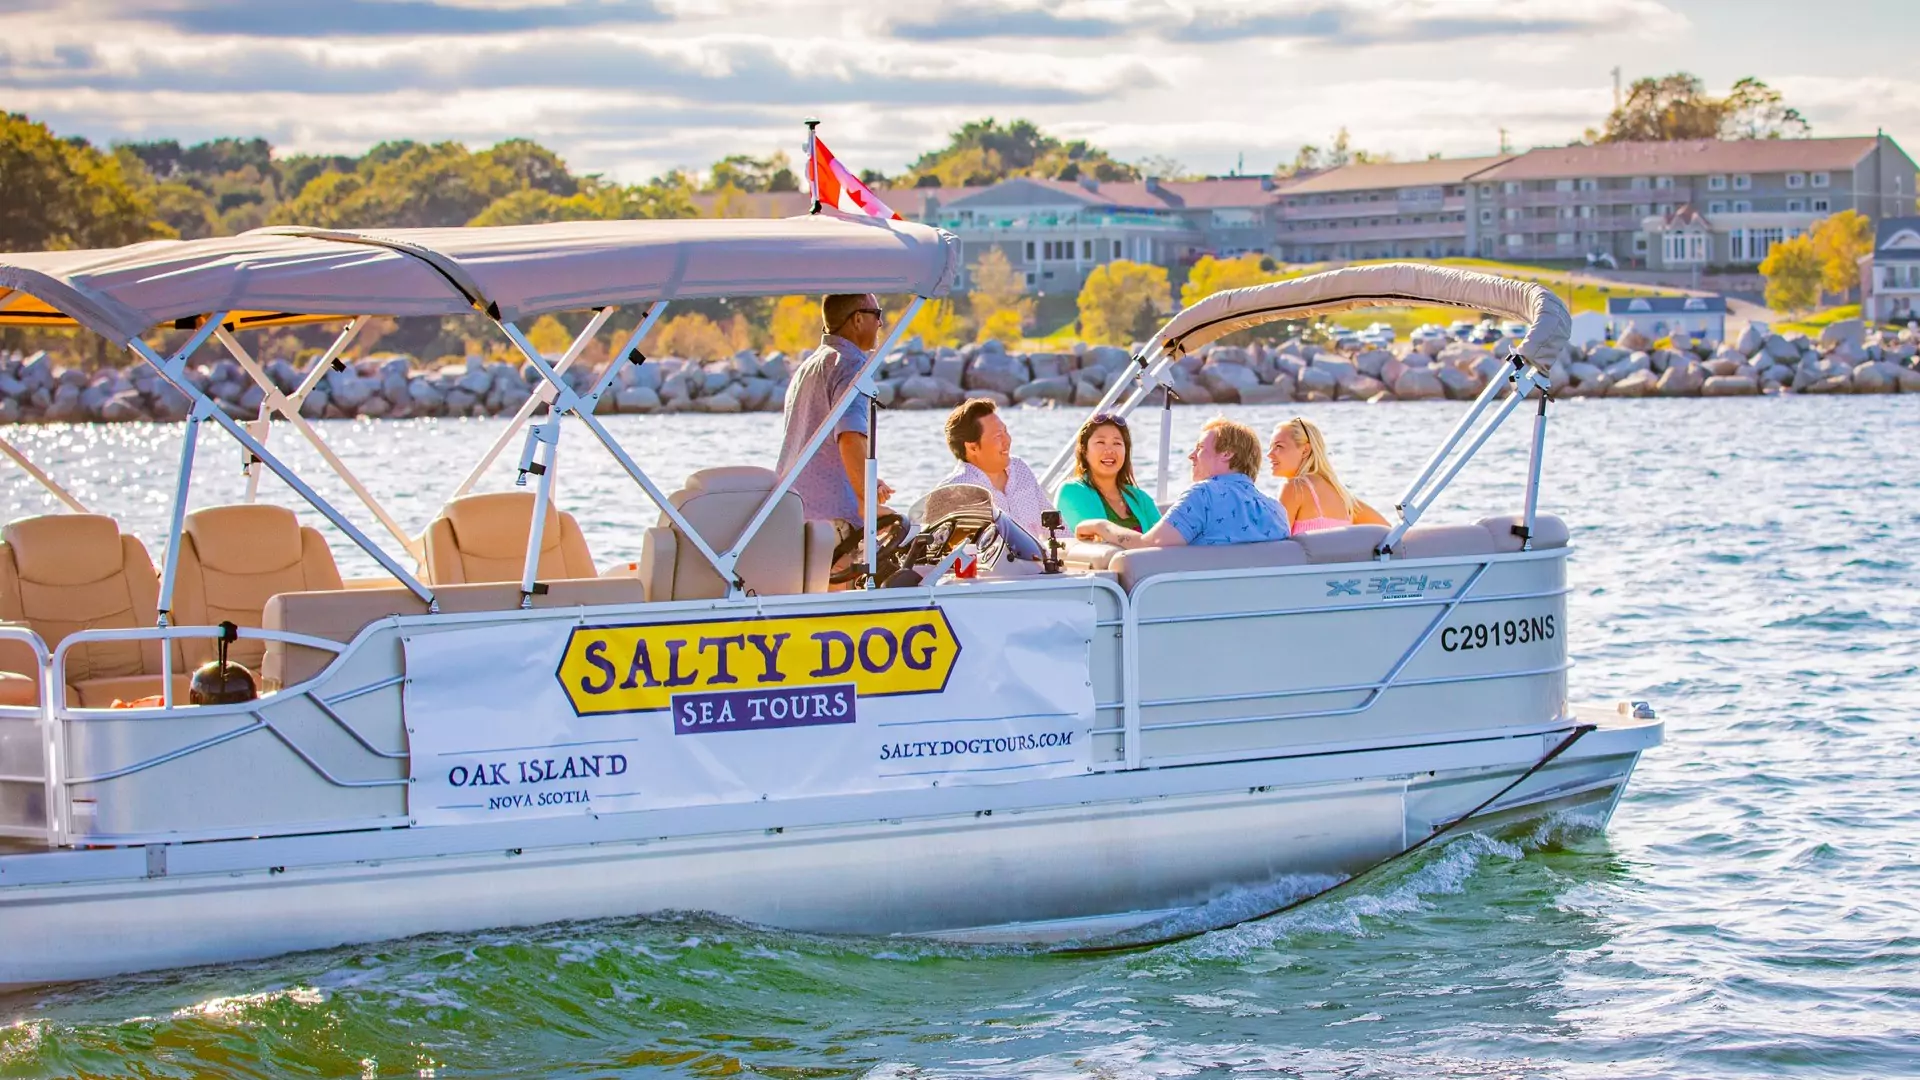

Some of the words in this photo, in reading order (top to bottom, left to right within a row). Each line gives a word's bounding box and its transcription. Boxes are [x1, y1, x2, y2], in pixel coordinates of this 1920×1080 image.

[1365, 574, 1428, 595] 324
[1441, 614, 1555, 652] C29193NS
[581, 632, 791, 695] SALTY
[809, 623, 938, 678] DOG
[681, 700, 732, 727] SEA
[747, 692, 848, 723] TOURS
[879, 731, 1074, 761] SALTYDOGTOURS.COM
[448, 762, 510, 787] OAK
[518, 754, 628, 784] ISLAND
[488, 795, 533, 810] NOVA
[537, 790, 590, 806] SCOTIA
